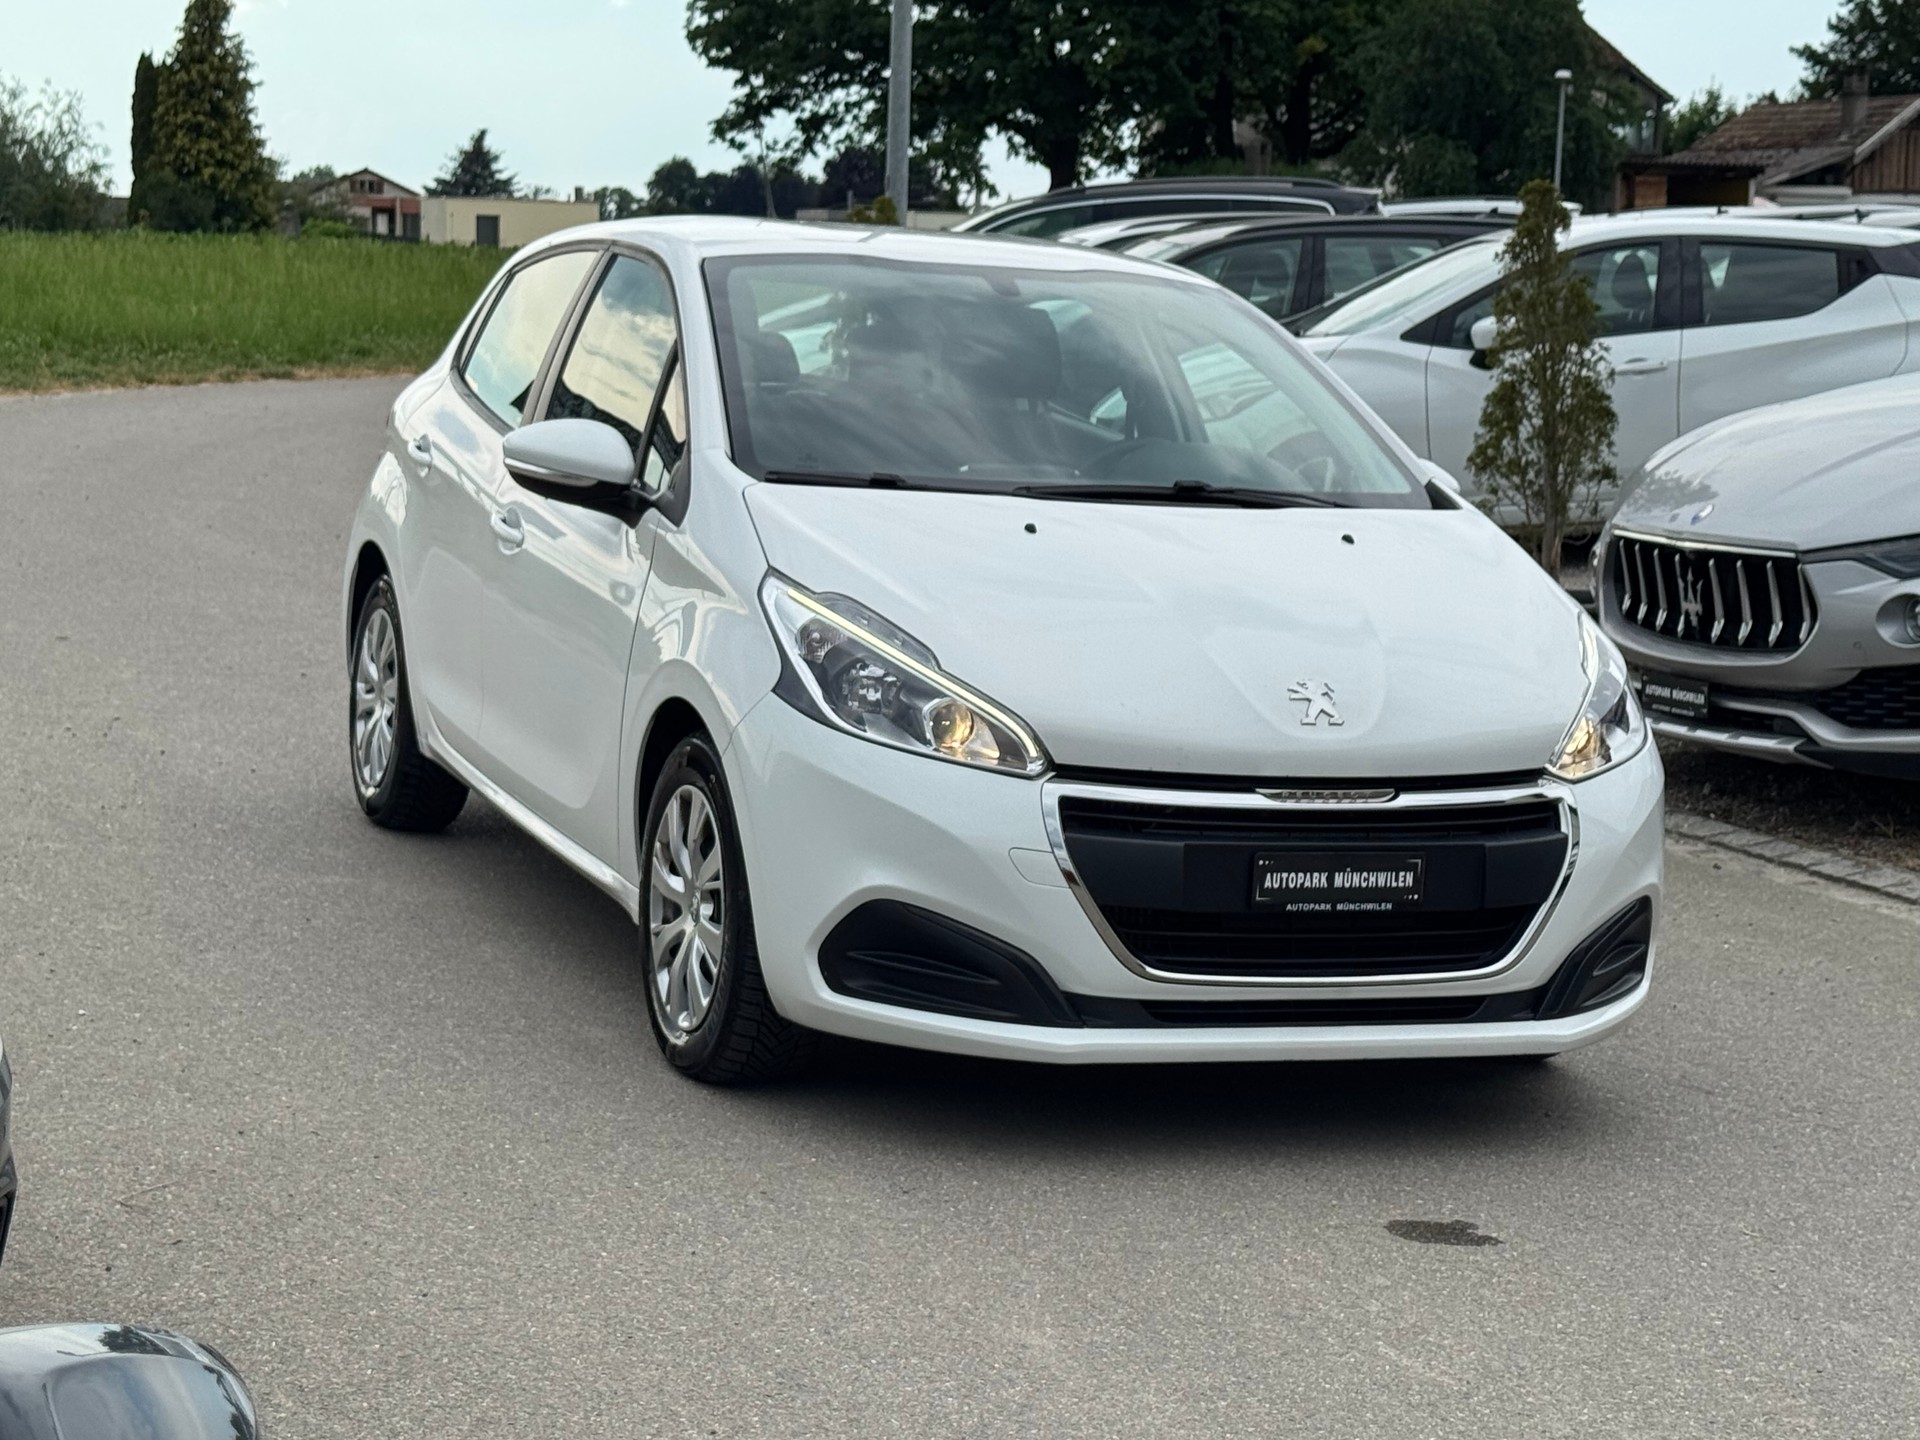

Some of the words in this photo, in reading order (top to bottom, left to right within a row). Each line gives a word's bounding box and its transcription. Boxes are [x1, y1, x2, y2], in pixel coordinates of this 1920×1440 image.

[1264, 872, 1328, 888] AUTOPARK
[1334, 868, 1414, 888] MÜNCHWILEN
[1286, 903, 1331, 911] AUTOPARK
[1336, 902, 1392, 911] MÜNCHWILEN
